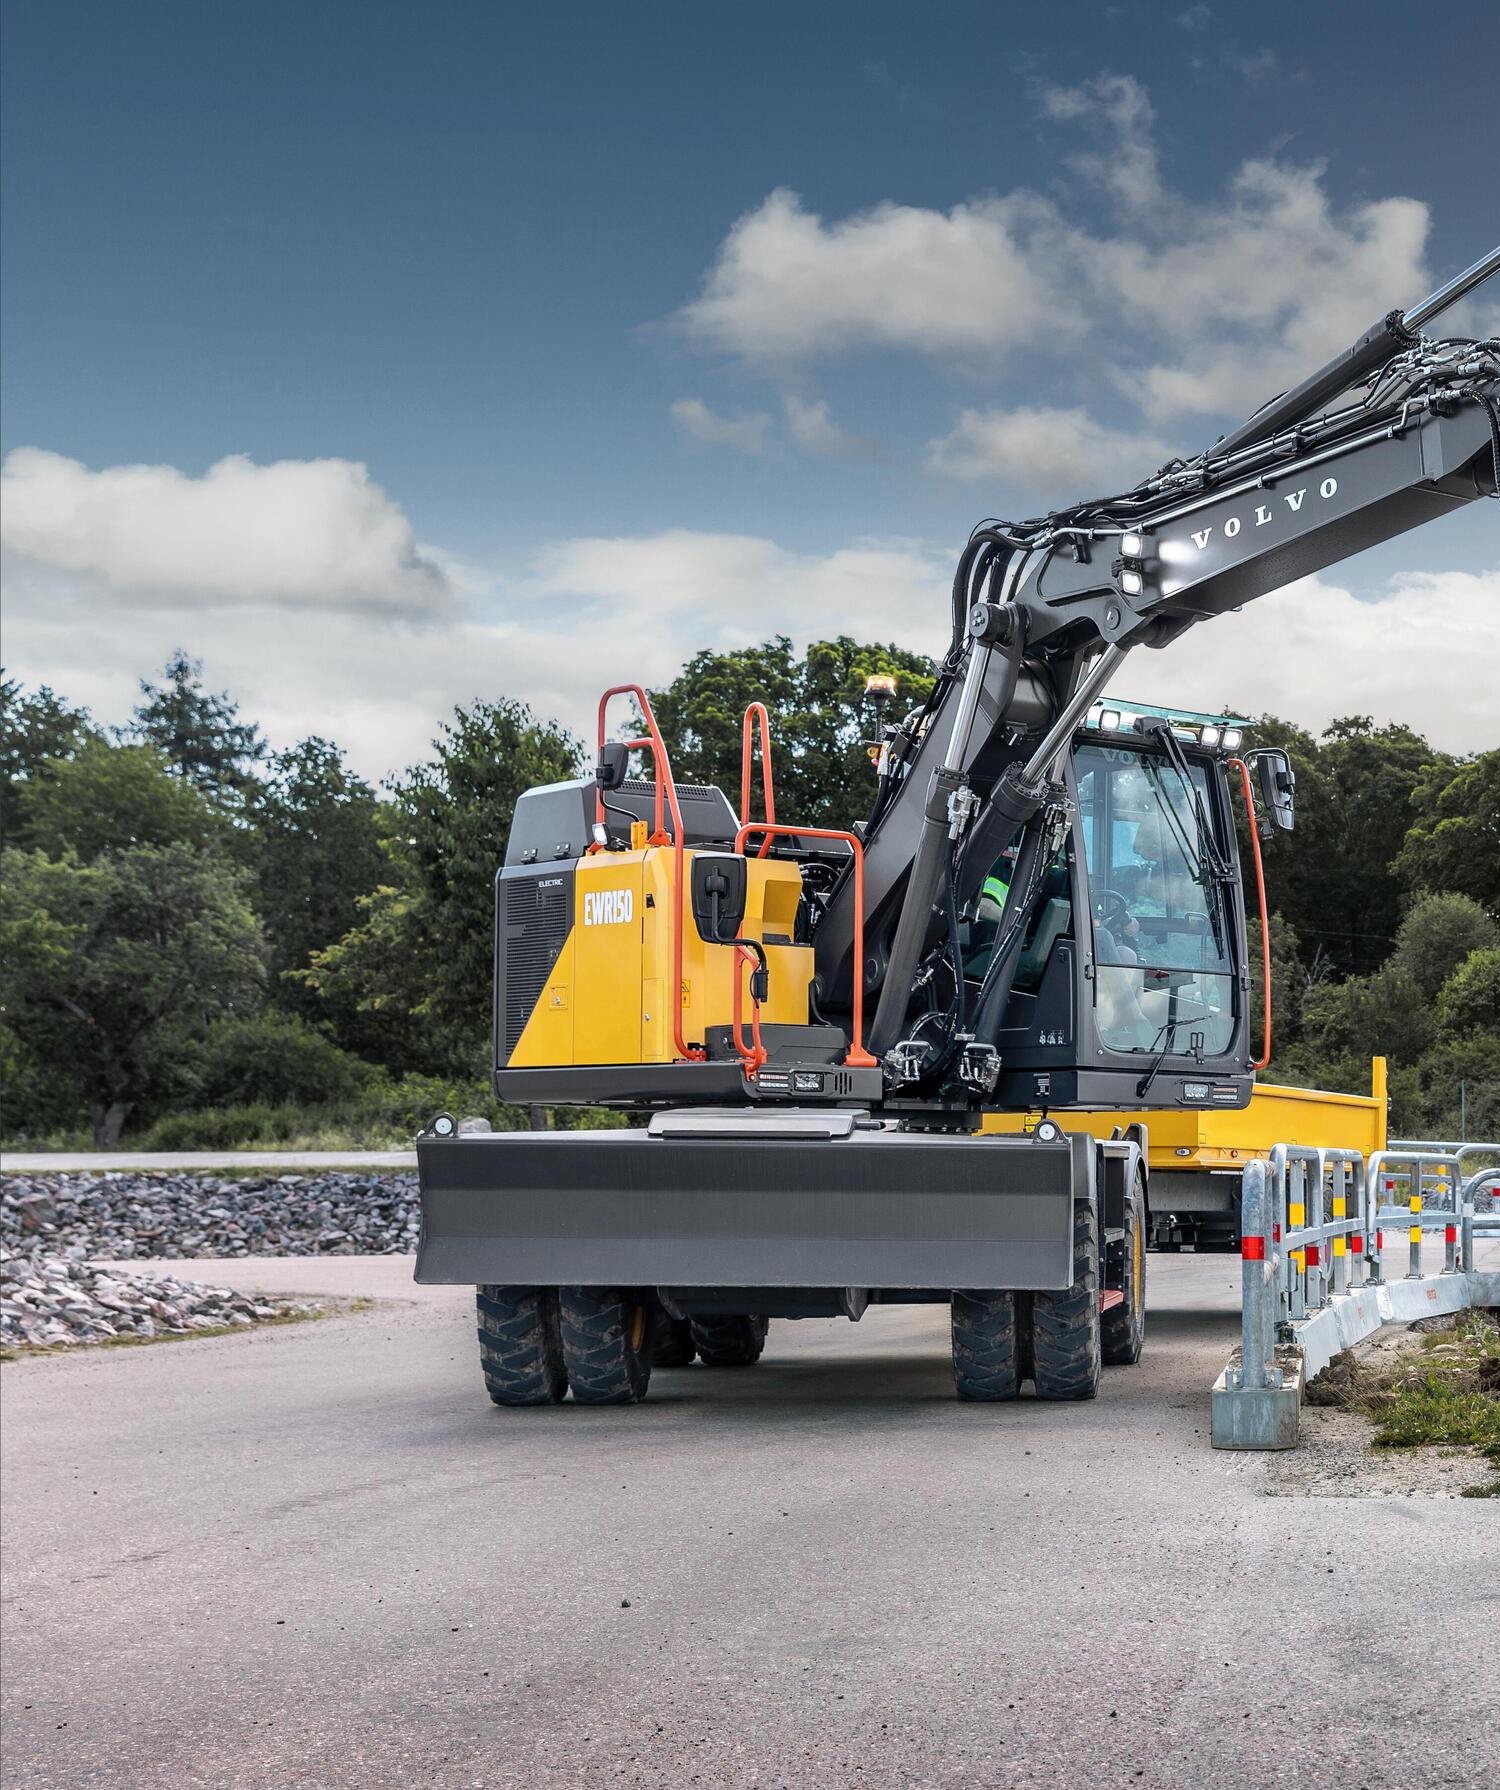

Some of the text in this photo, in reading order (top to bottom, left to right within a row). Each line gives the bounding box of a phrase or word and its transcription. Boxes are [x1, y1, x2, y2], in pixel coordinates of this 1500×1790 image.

[1190, 477, 1338, 550] VOLVO
[538, 878, 564, 888] ELECTRIC
[584, 889, 633, 926] EWR150
